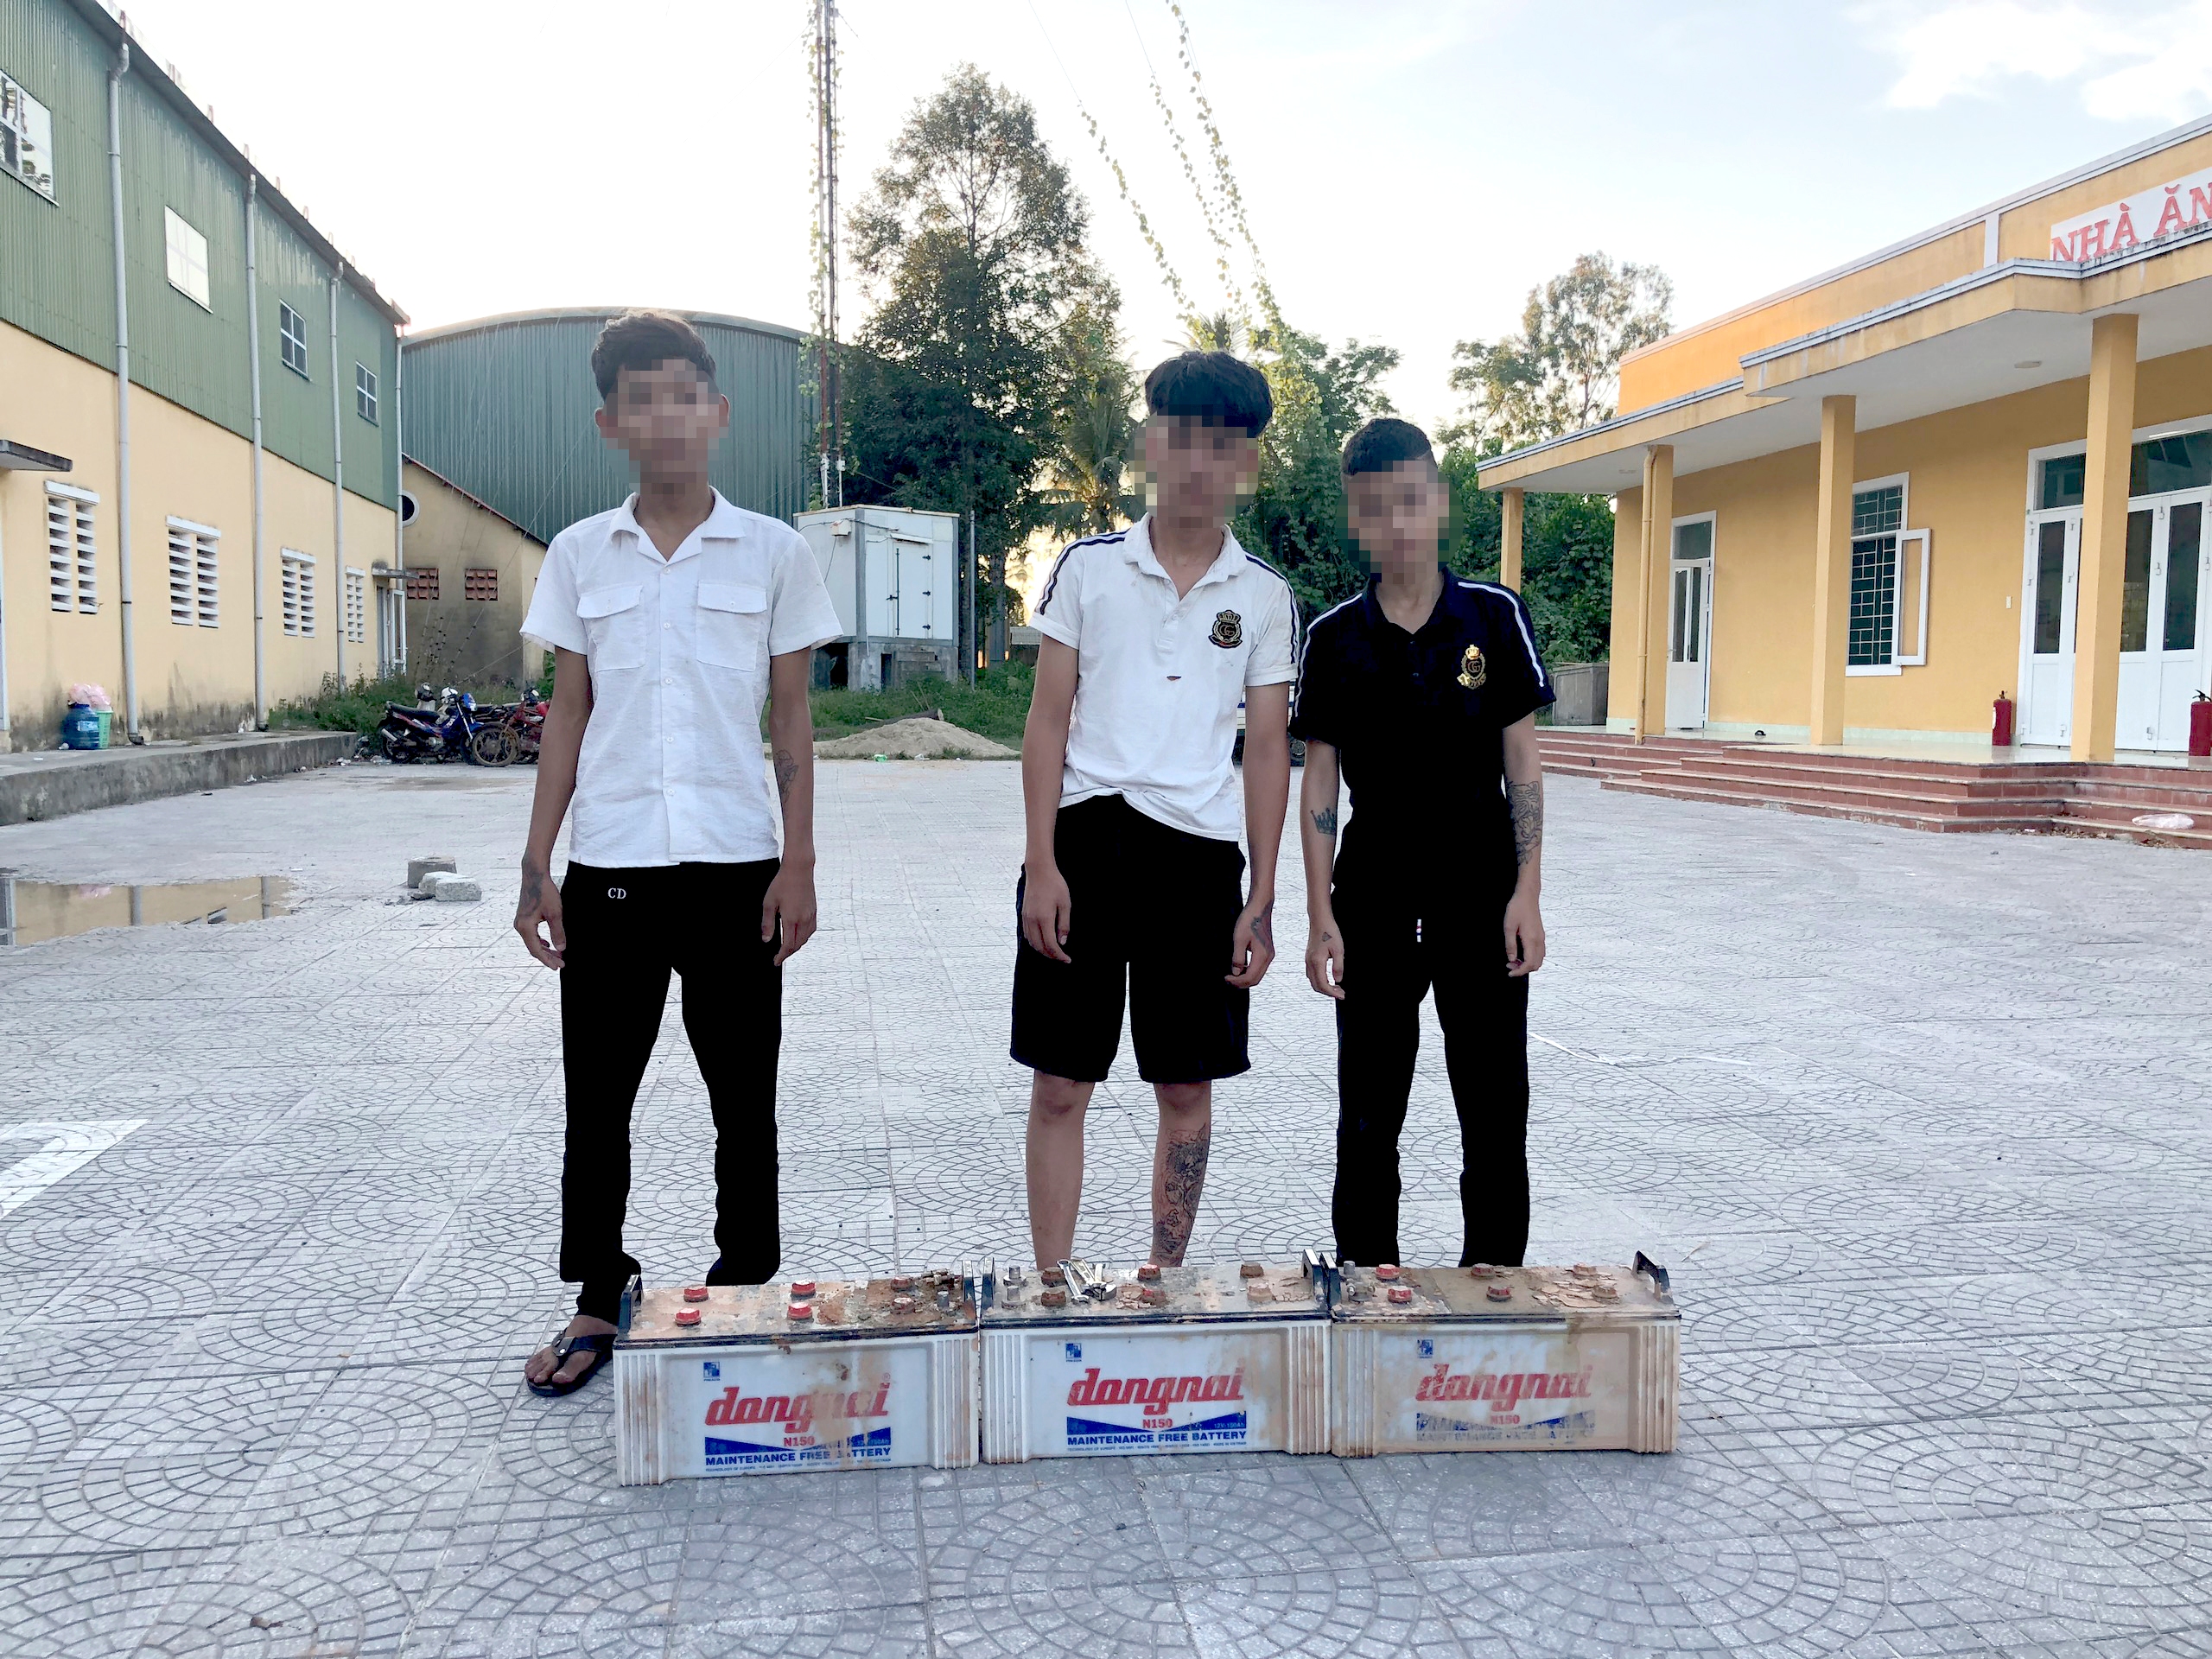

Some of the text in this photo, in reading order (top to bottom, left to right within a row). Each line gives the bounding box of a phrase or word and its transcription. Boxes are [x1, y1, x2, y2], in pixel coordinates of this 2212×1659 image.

[2051, 183, 2212, 263] NHÀ ĂN
[607, 887, 626, 899] CD
[1142, 1418, 1173, 1429] N150
[783, 1436, 816, 1447] N150
[1067, 1430, 1247, 1446] MAINTENANCE FREE BATTERY
[705, 1452, 796, 1465] MAINTENANCE
[799, 1451, 831, 1461] FREE
